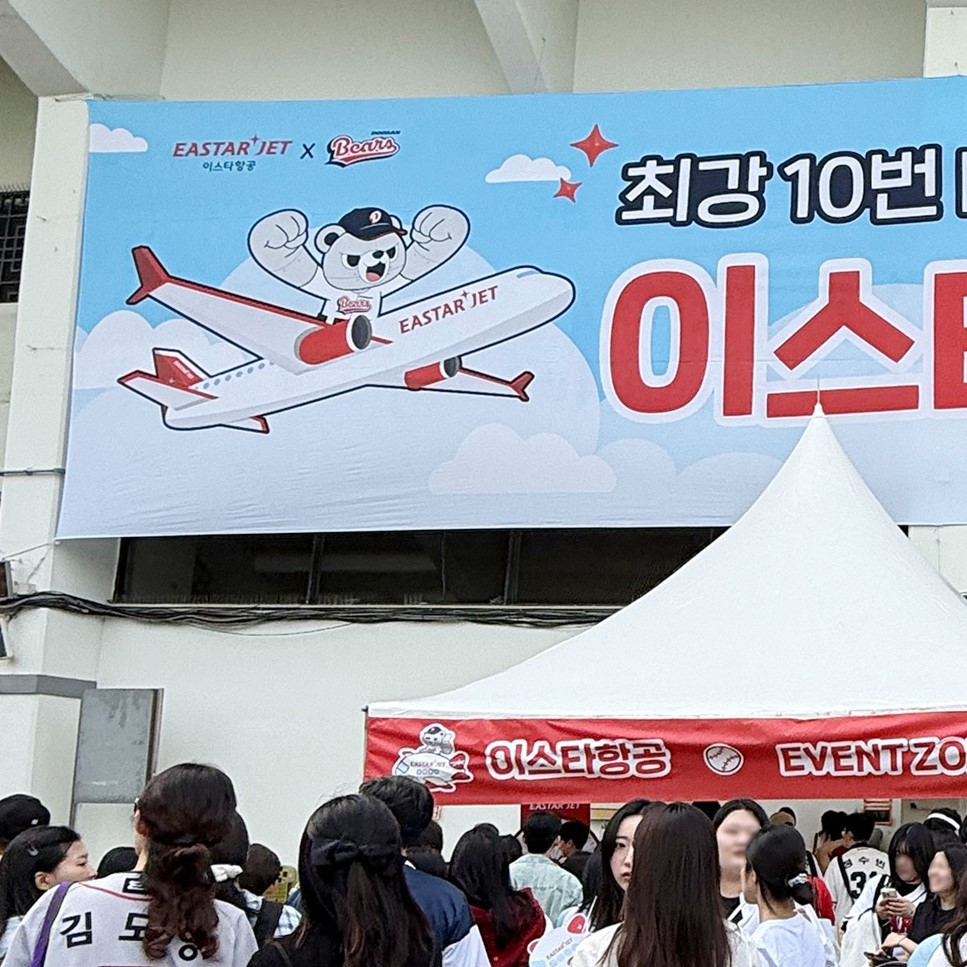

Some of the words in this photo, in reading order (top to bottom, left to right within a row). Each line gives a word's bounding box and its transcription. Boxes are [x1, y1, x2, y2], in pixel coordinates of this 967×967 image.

[173, 141, 249, 157] EASTAR
[254, 140, 293, 156] JET
[330, 136, 399, 163] Bears
[202, 160, 256, 173] 이스타항공
[620, 152, 769, 227] 최강
[781, 144, 942, 225] 10번
[399, 299, 464, 334] EASTAR
[467, 285, 499, 309] JET
[485, 740, 669, 780] 이스타항공
[779, 741, 908, 776] EVENT
